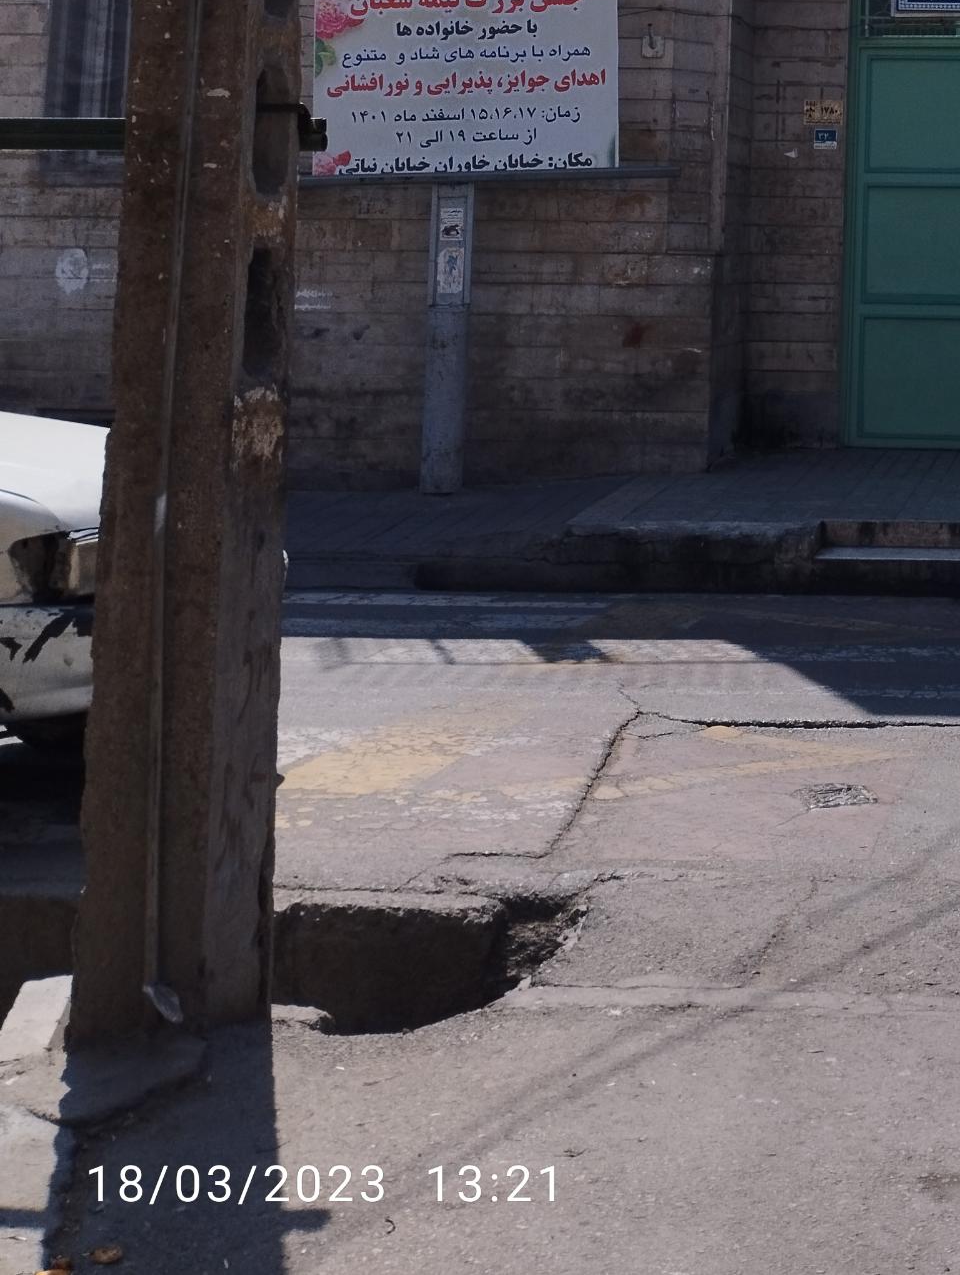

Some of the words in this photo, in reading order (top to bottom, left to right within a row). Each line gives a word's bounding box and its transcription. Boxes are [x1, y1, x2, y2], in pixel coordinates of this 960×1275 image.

[396, 21, 412, 37] ها
[415, 21, 474, 41] خانواده
[477, 24, 523, 40] حضور
[526, 19, 538, 35] با
[342, 50, 387, 68] متنوع
[397, 53, 406, 66] و
[410, 47, 440, 61] شاد
[444, 47, 475, 64] های
[479, 47, 527, 64] برنامه
[531, 45, 544, 61] با
[548, 44, 591, 62] همراه
[414, 80, 422, 96] و
[426, 71, 493, 95] پذیرایی
[553, 69, 607, 92] اهدای
[351, 109, 387, 124] ۱۴۰۱
[393, 112, 417, 123] ماه
[421, 107, 465, 123] اسفند
[541, 105, 581, 123] زمان:
[395, 129, 412, 144] ۲۱
[419, 130, 444, 148] الی
[449, 129, 466, 143] ۱۹
[472, 128, 519, 143] ساعت
[522, 127, 537, 146] از
[434, 155, 490, 174] خاوران
[547, 152, 593, 171] مکان:
